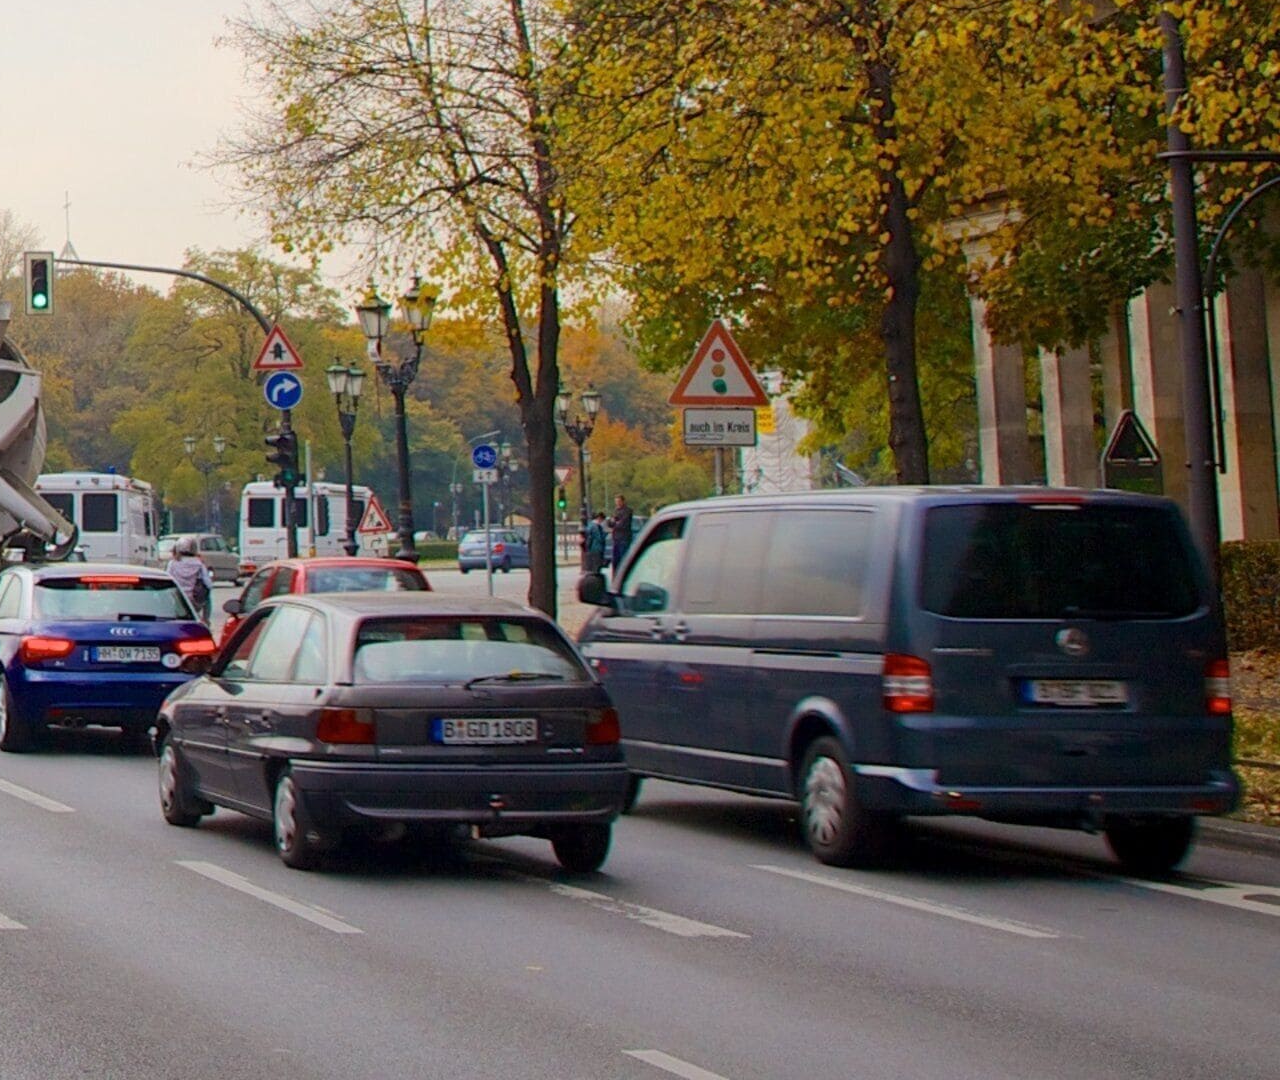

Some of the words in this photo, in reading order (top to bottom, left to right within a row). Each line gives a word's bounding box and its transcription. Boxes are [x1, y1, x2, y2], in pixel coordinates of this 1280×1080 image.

[690, 421, 711, 433] auch
[727, 421, 751, 433] Kreis
[444, 721, 455, 738] B
[491, 721, 535, 738] 1808
